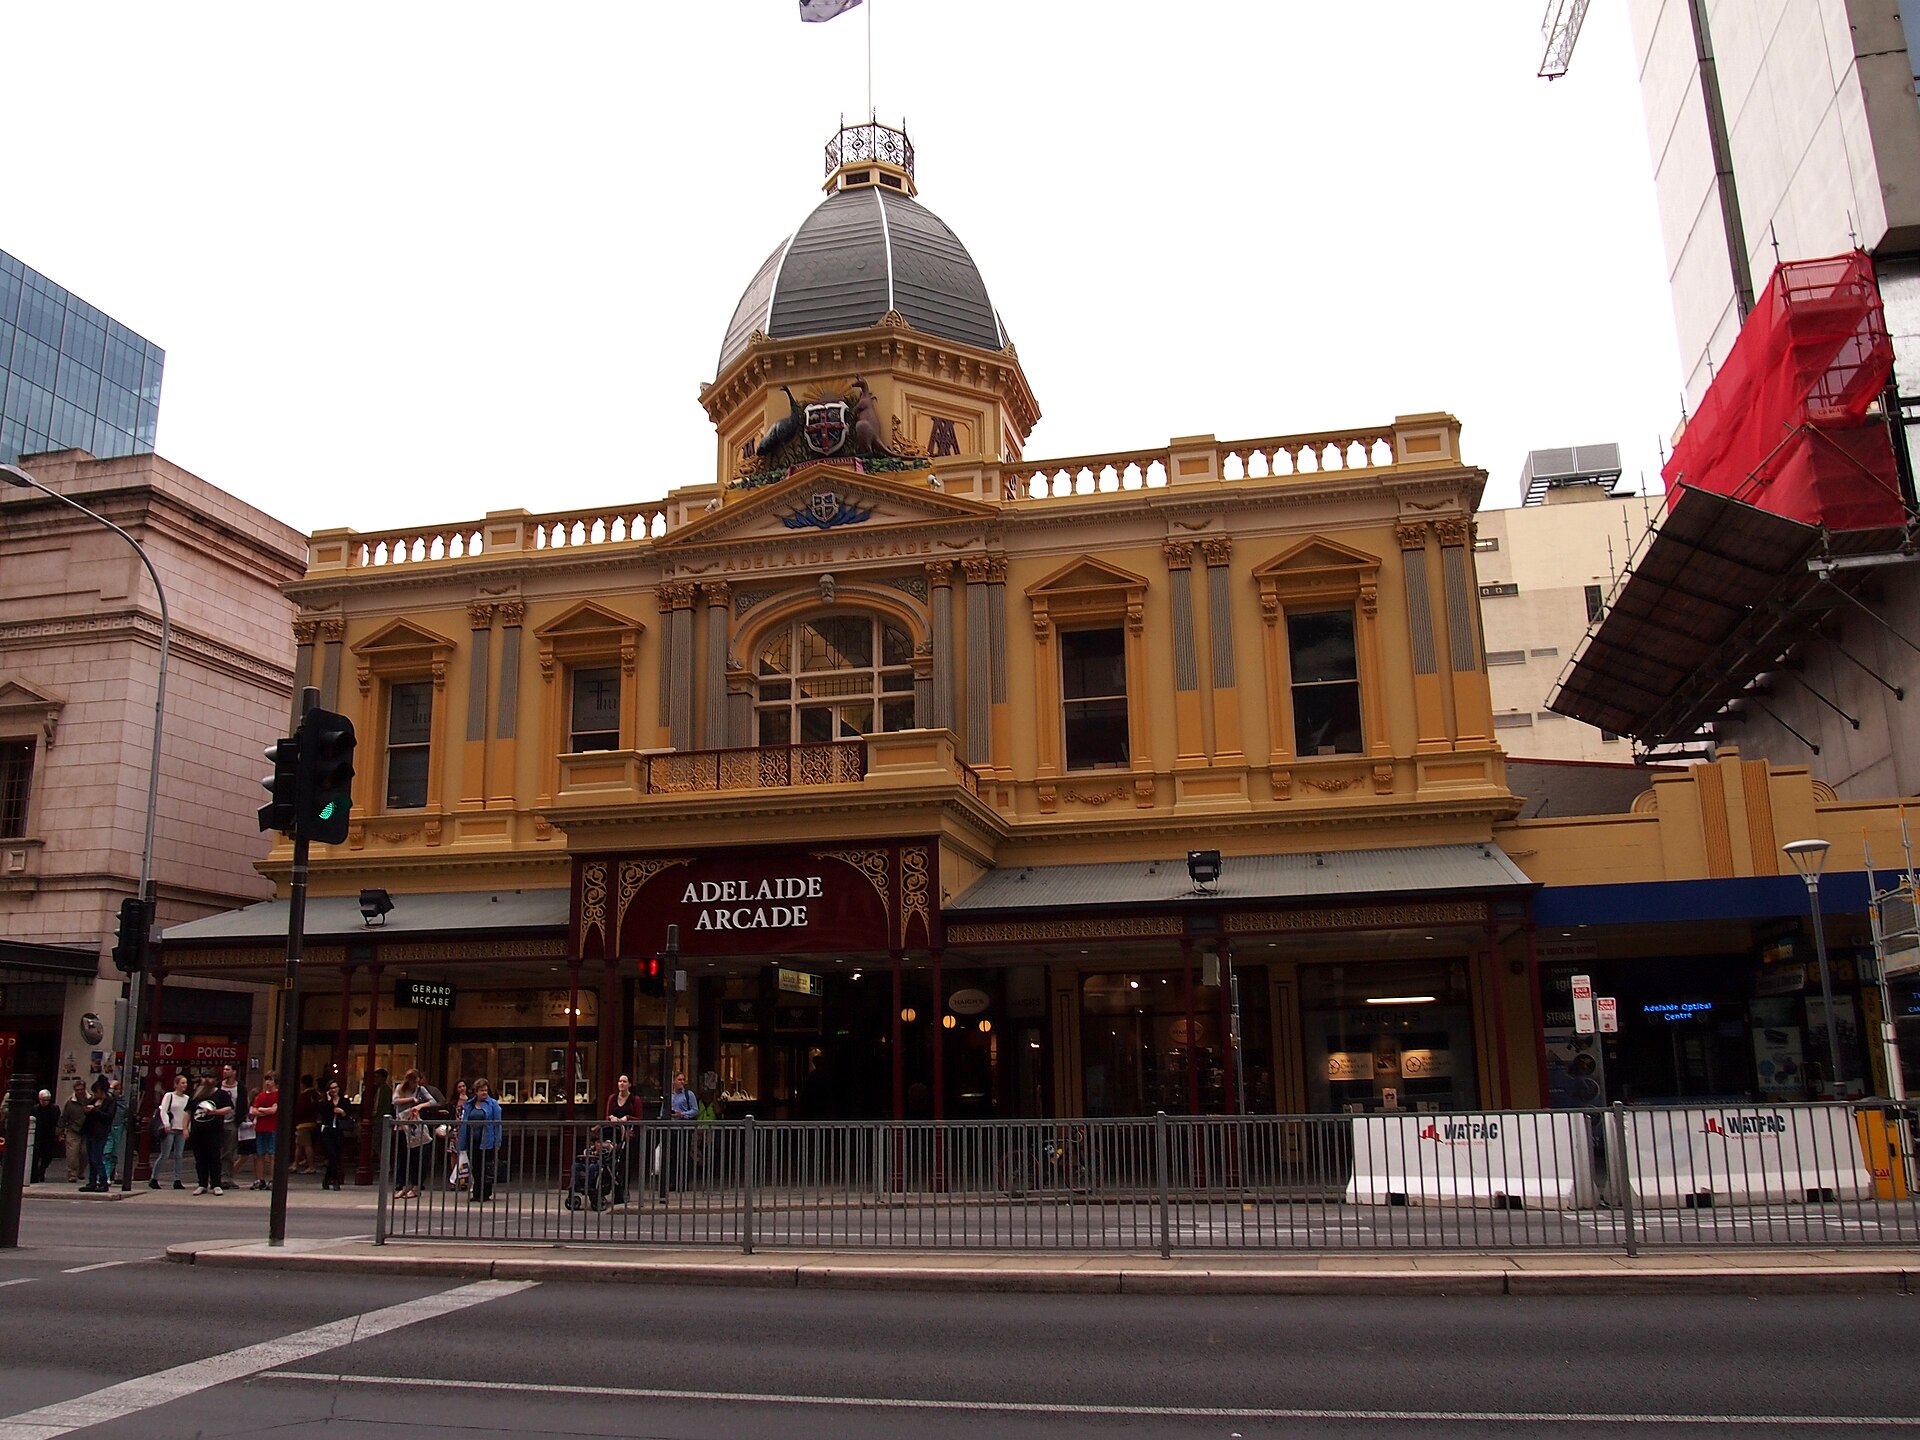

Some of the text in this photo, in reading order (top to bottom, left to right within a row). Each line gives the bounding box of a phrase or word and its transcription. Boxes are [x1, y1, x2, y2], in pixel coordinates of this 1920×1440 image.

[723, 541, 932, 572] ADELAIDE ARCADE
[681, 877, 823, 903] ADELAIDE
[694, 905, 808, 930] ARCADE
[411, 983, 451, 995] GERARD
[1643, 1002, 1712, 1012] Adelaide Optical
[1664, 1012, 1693, 1021] Centre
[196, 1046, 237, 1058] POKIES
[1444, 1123, 1498, 1140] WATPAC
[1726, 1115, 1786, 1133] WATPAC
